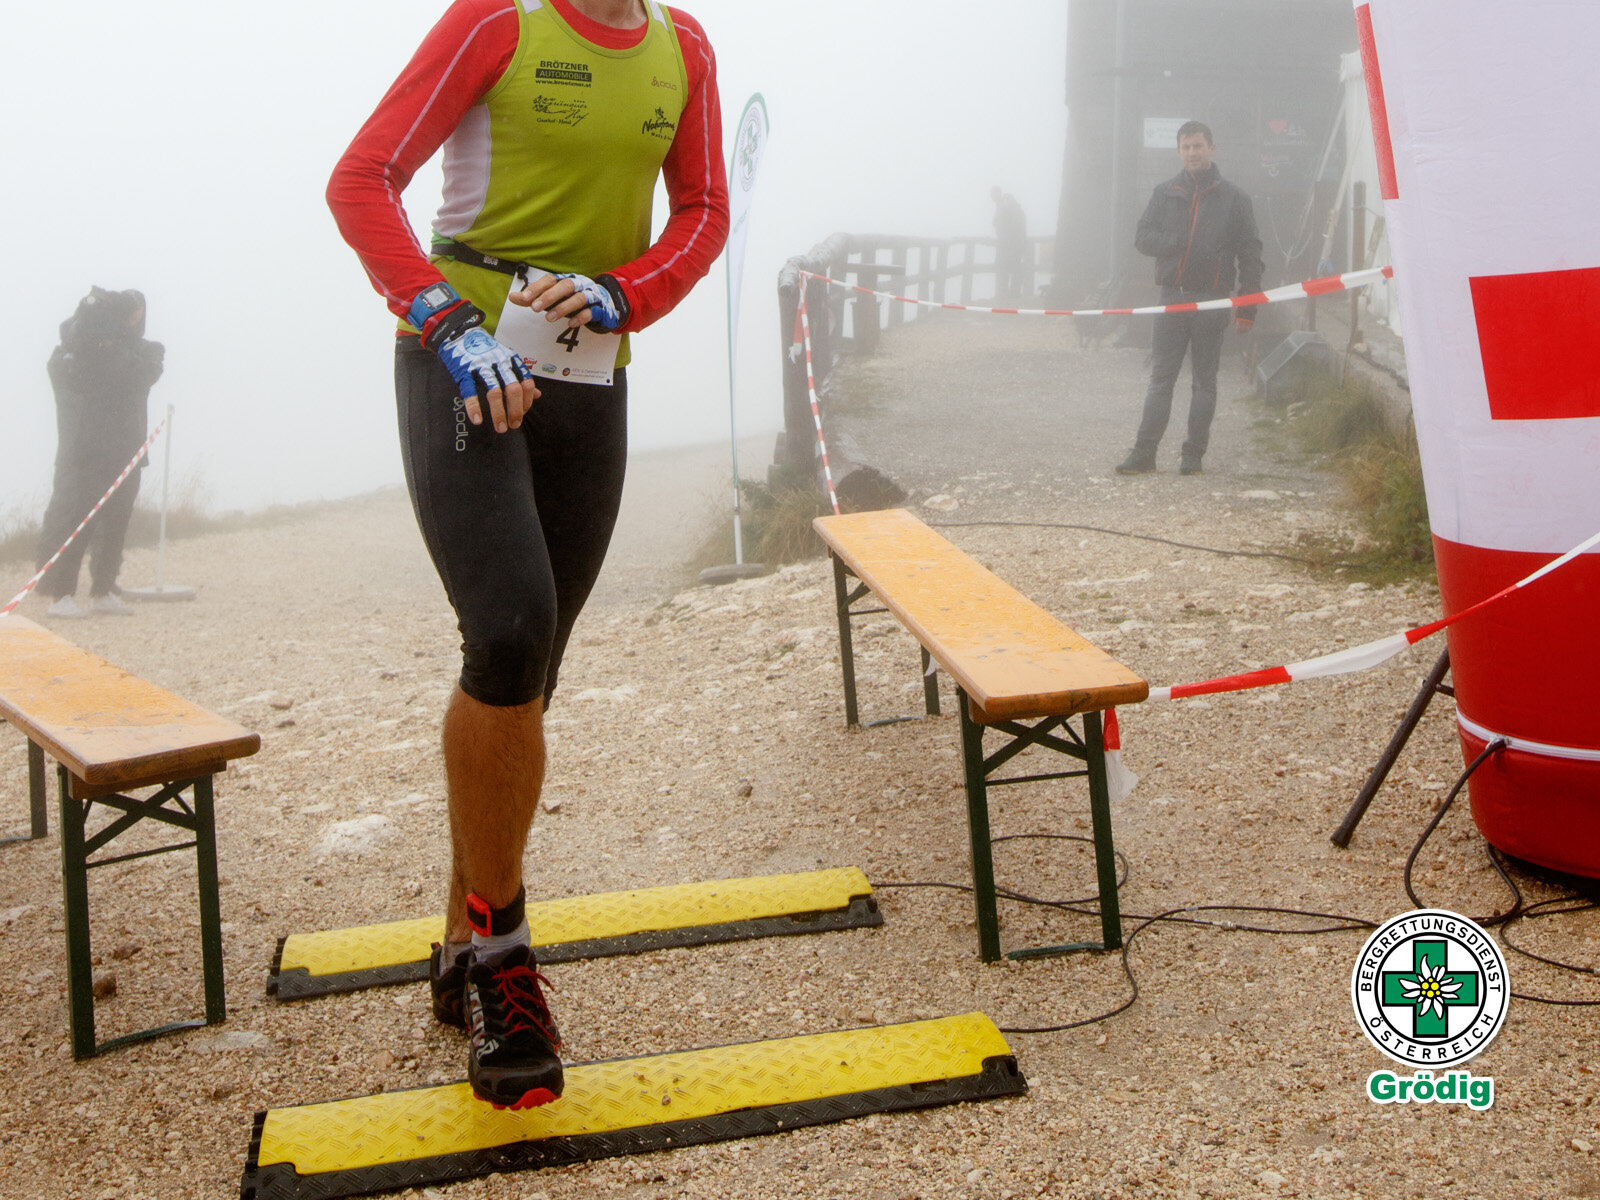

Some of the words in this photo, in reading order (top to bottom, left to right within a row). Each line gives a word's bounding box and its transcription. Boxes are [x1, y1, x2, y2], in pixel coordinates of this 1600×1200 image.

[540, 60, 589, 71] BRÖTZNER
[539, 70, 590, 81] AUTOMOBILE
[555, 326, 580, 353] 4
